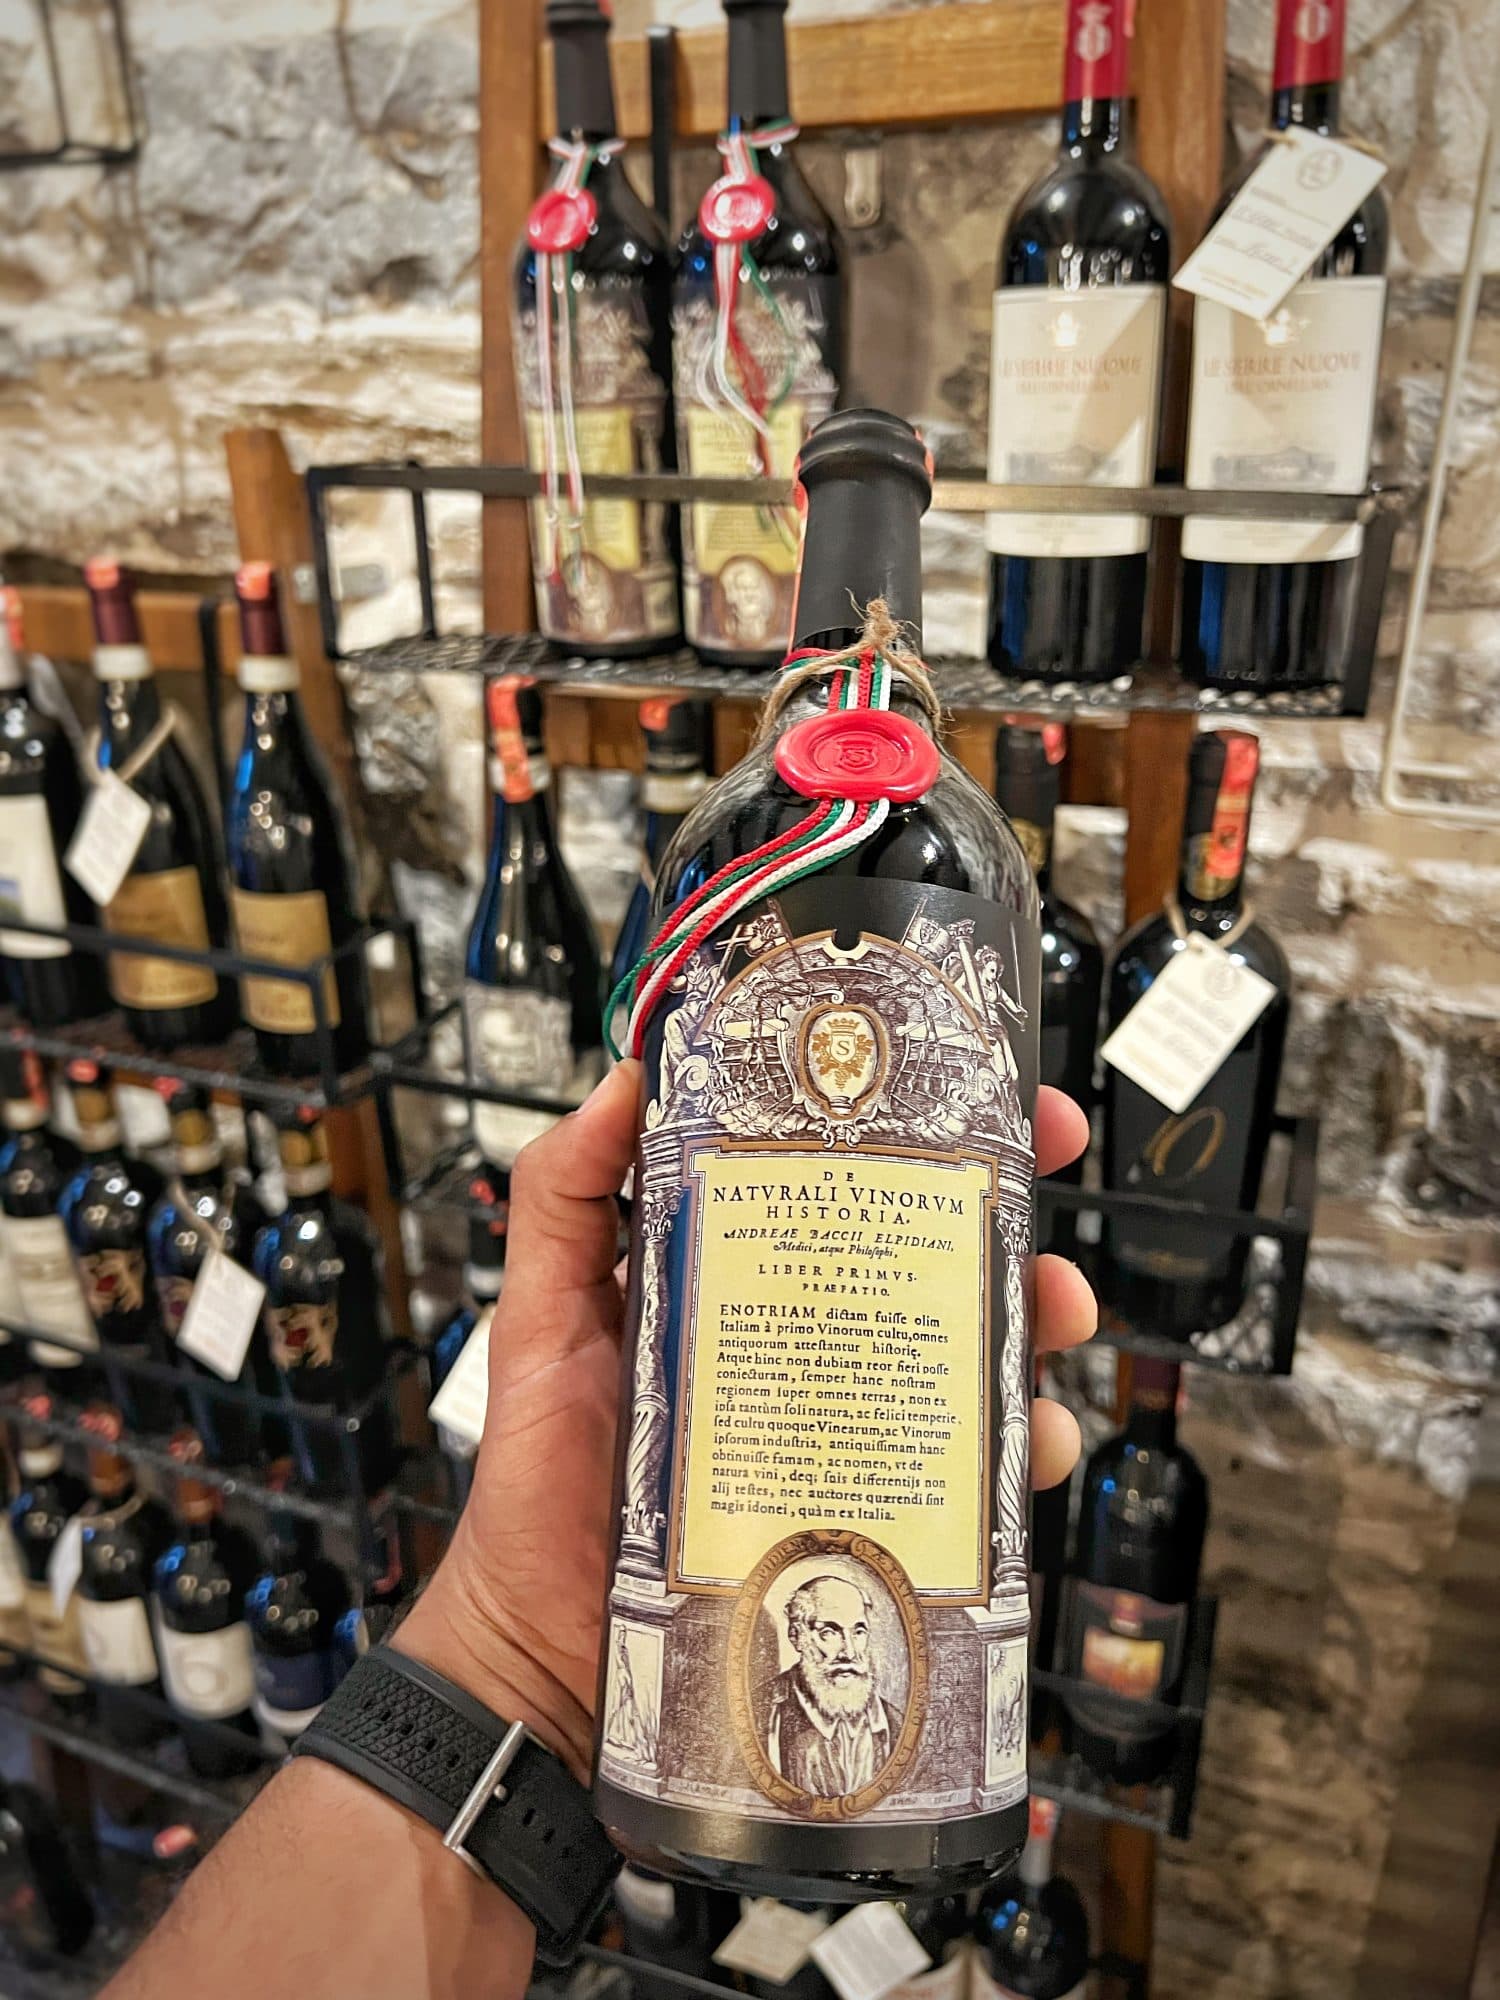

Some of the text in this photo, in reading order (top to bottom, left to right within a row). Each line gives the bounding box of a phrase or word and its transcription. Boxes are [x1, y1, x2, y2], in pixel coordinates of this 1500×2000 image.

[836, 1040, 850, 1056] S
[713, 1186, 964, 1214] NATVRALI VINORVM
[767, 1206, 910, 1224] HISTORIA.
[810, 1230, 863, 1241] BACCII
[875, 1233, 954, 1251] ELPIDIANI,
[759, 1264, 917, 1282] LIBER PRIMVS.
[720, 1304, 815, 1318] ENOTRIAM
[826, 1308, 867, 1321] dictam
[914, 1315, 940, 1327] olim
[720, 1321, 760, 1332] Italiam
[777, 1322, 814, 1336] primo
[818, 1323, 873, 1337] Vinorum
[719, 1337, 787, 1351] antiquorum
[717, 1352, 752, 1366] Atque
[755, 1353, 781, 1365] hinc
[787, 1358, 810, 1366] non
[815, 1355, 862, 1369] dubiam
[867, 1362, 892, 1371] reor
[898, 1361, 920, 1373] fieri
[853, 1372, 883, 1385] hanc
[716, 1385, 770, 1399] regionem
[816, 1391, 857, 1400] omnes
[909, 1395, 931, 1405] non
[934, 1398, 947, 1406] ex
[856, 1410, 870, 1419] ac
[874, 1408, 905, 1421] felici
[734, 1417, 764, 1429] cultu
[767, 1421, 815, 1433] quoque
[902, 1426, 951, 1439] Vinorum
[920, 1441, 946, 1455] hanc
[828, 1458, 841, 1467] ac
[844, 1460, 891, 1471] nomen,
[909, 1460, 923, 1470] de
[712, 1468, 748, 1477] natura
[925, 1480, 946, 1488] non
[780, 1489, 802, 1497] nec
[808, 1489, 862, 1501] auctores
[711, 1500, 744, 1514] magis
[839, 1510, 855, 1518] ex
[859, 1508, 895, 1520] Italia.
